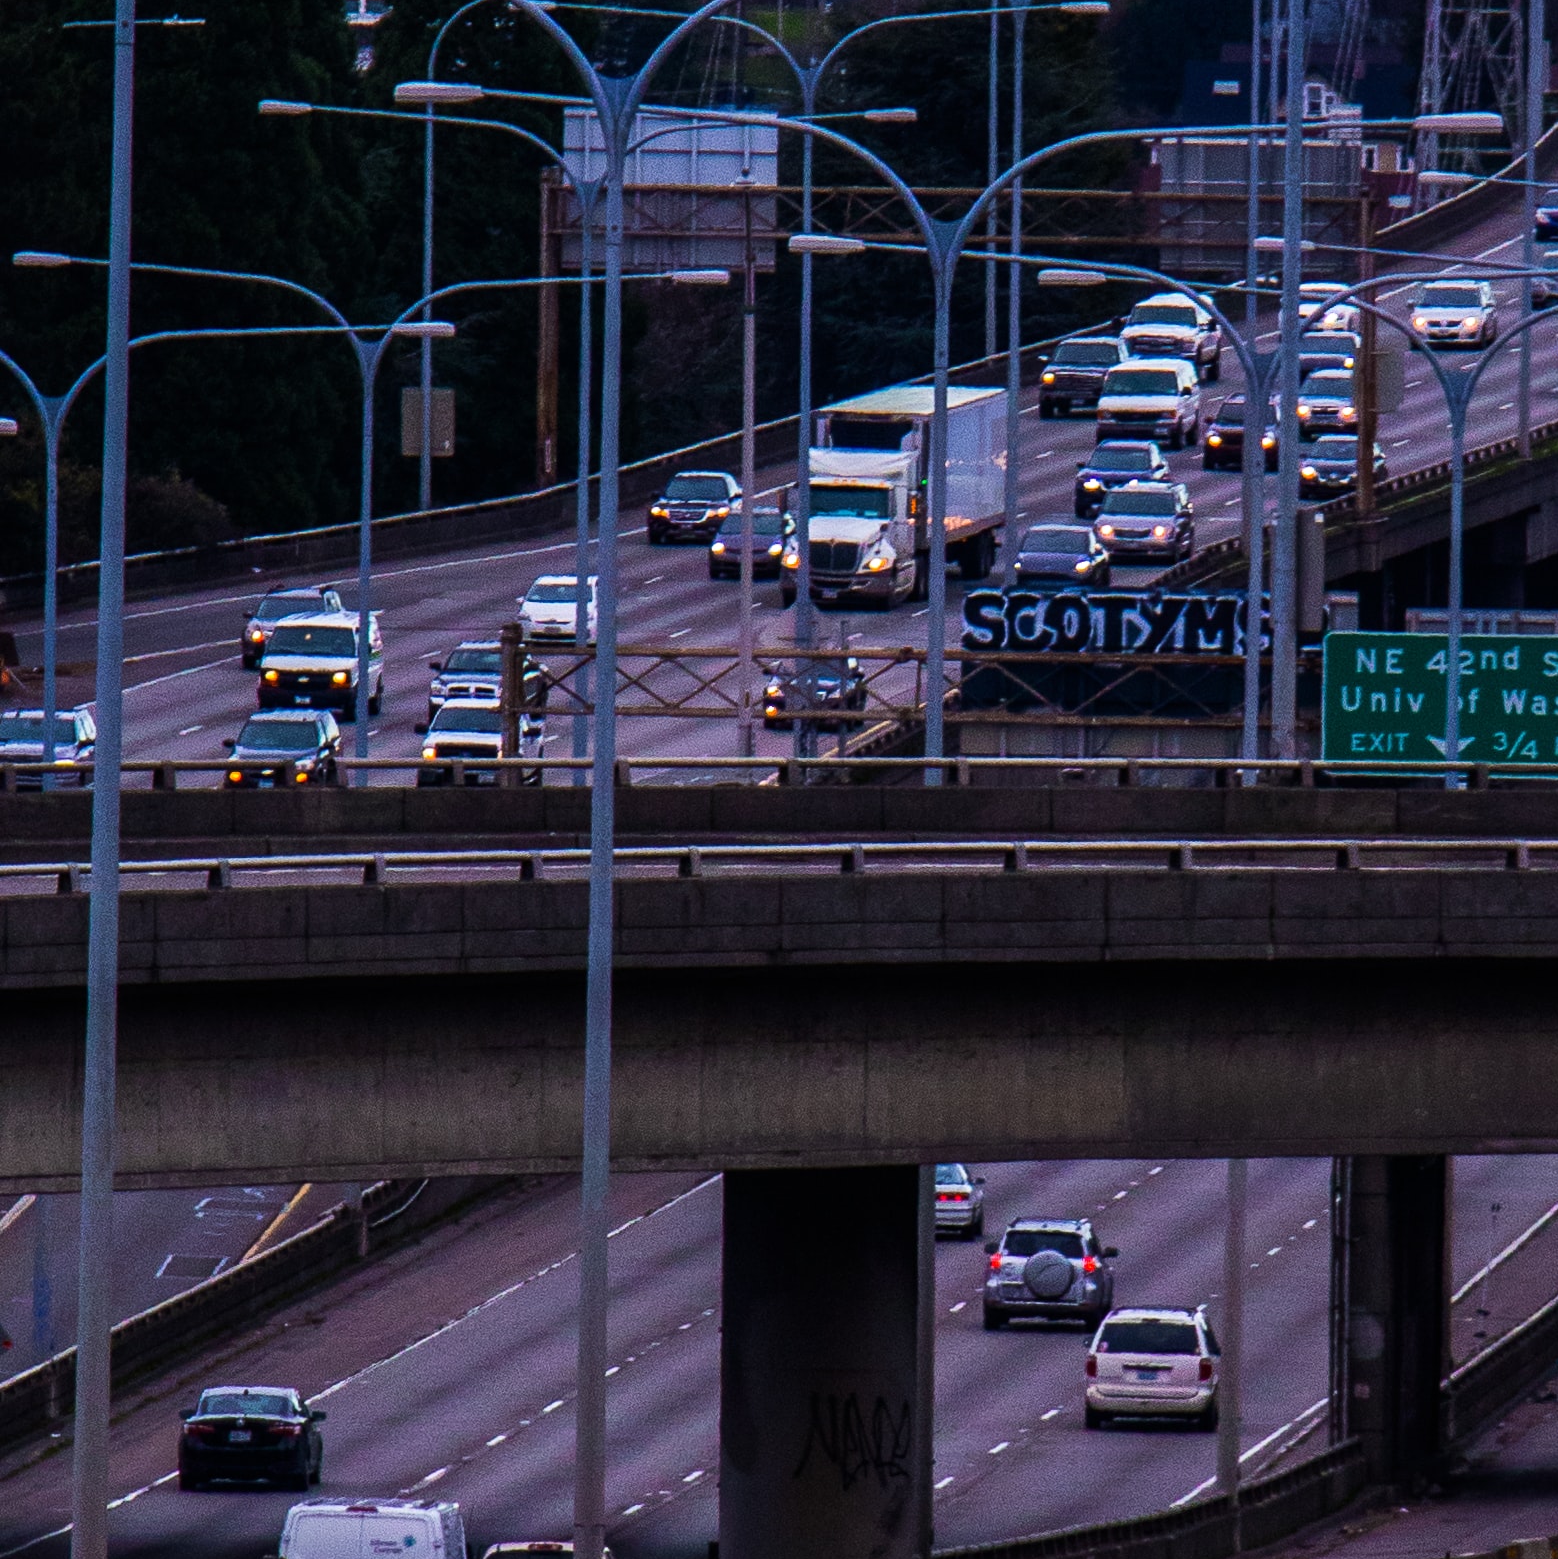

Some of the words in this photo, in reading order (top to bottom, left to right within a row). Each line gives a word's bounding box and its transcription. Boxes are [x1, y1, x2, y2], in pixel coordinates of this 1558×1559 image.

[1356, 648, 1404, 674] NE
[1425, 646, 1521, 675] 42nd
[1341, 686, 1425, 713] Univ
[1351, 732, 1409, 753] EXIT
[1492, 731, 1539, 760] 3/4
